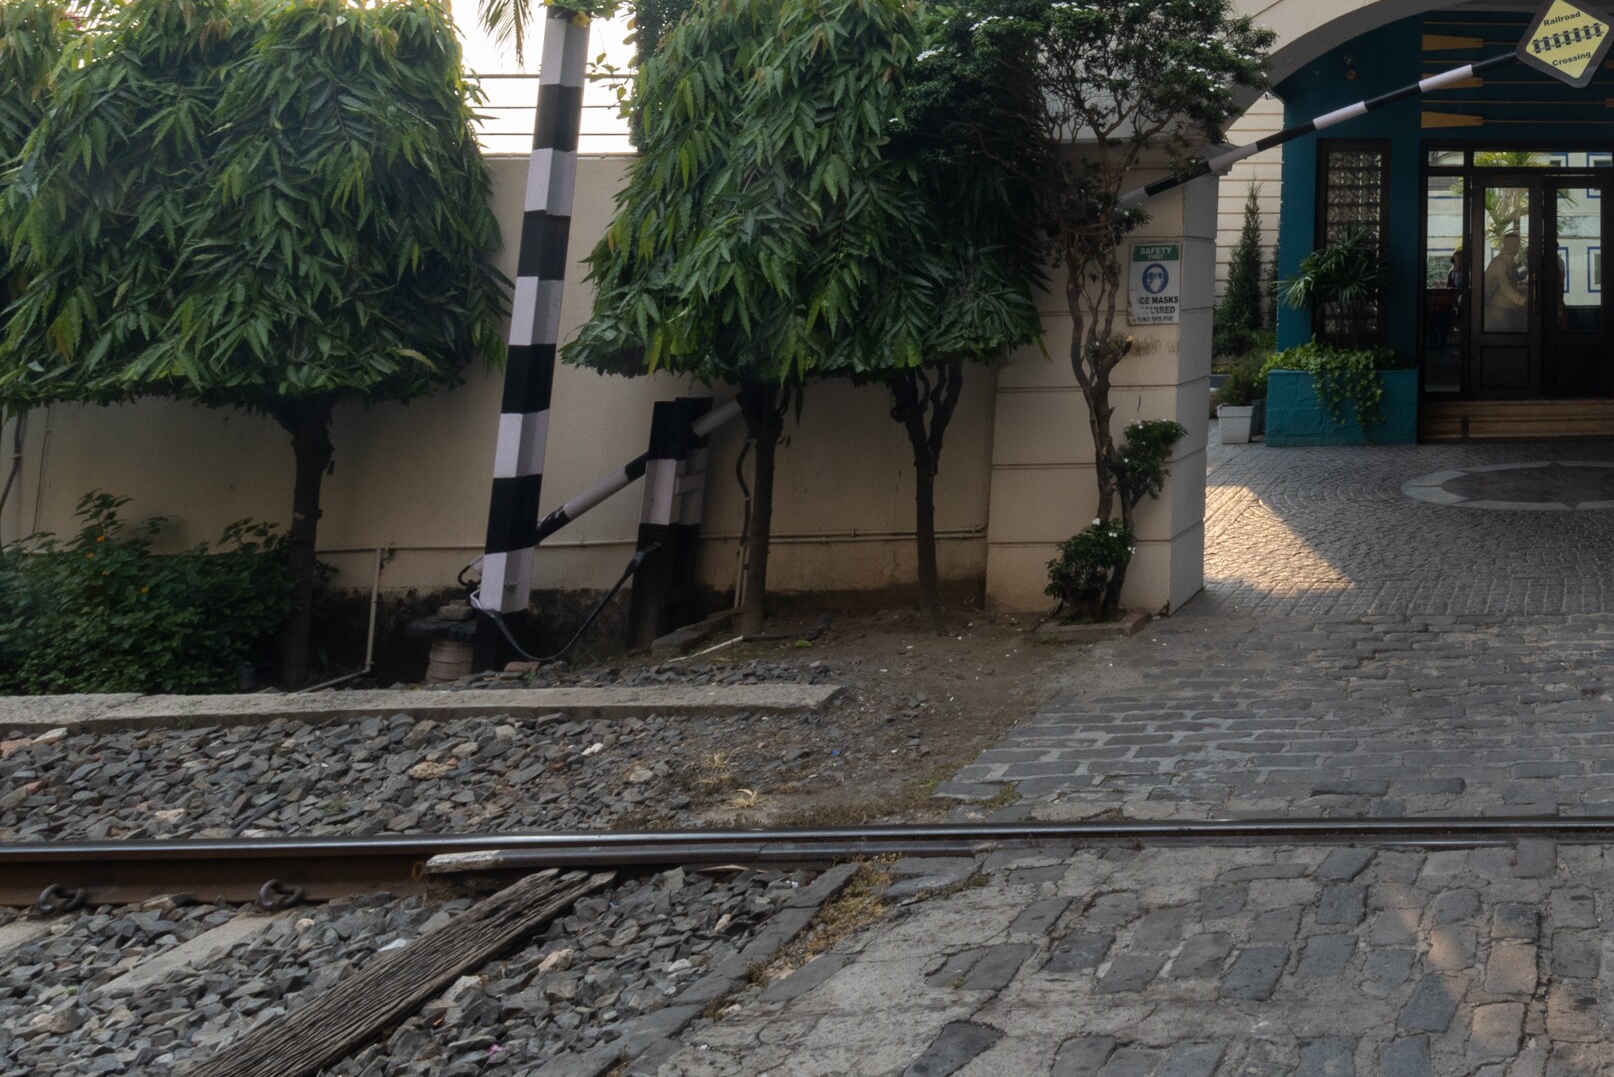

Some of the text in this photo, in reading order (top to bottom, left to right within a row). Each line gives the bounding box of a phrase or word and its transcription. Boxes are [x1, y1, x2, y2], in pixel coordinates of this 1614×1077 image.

[1543, 11, 1581, 27] Railroad
[1552, 51, 1591, 66] Crossing
[1140, 247, 1172, 255] SAFETY
[1152, 295, 1179, 304] MASKS
